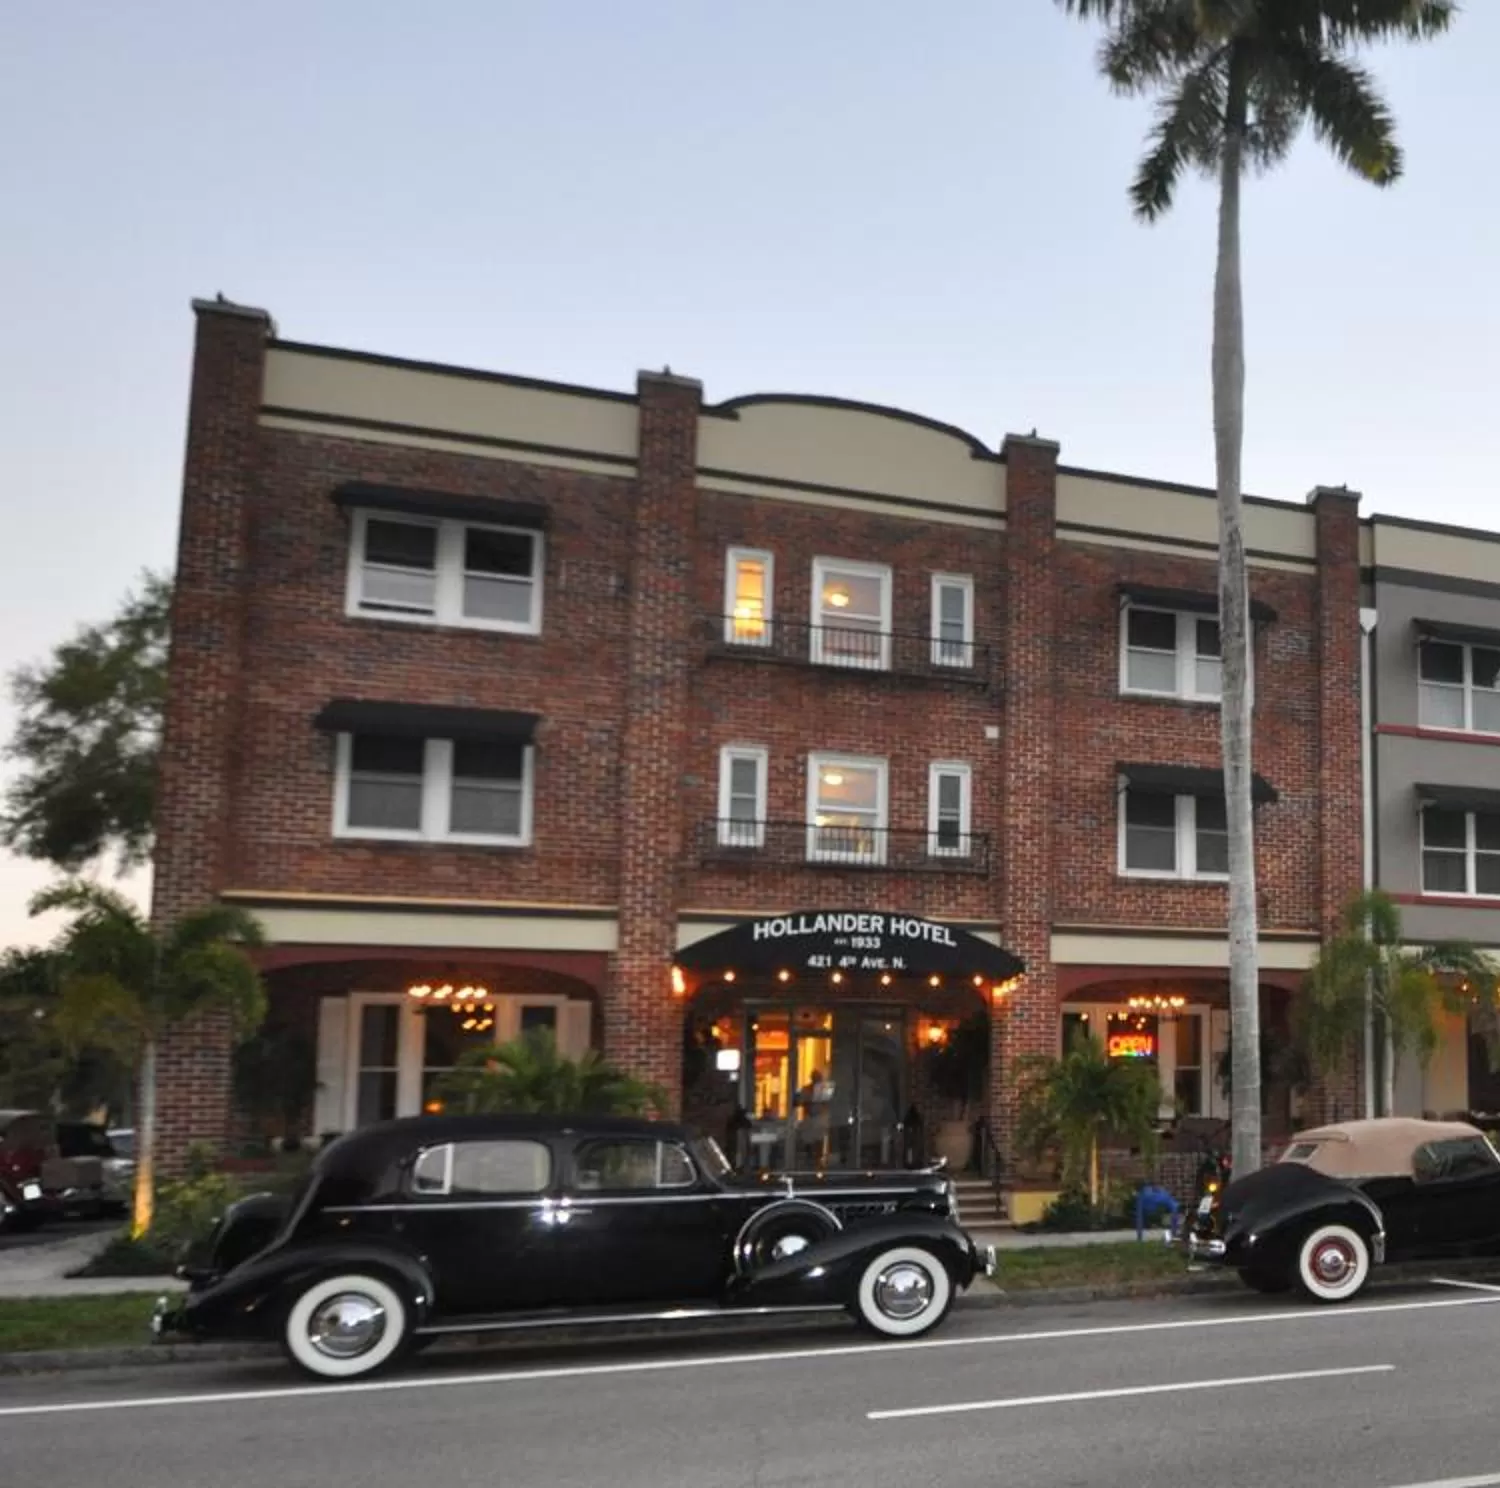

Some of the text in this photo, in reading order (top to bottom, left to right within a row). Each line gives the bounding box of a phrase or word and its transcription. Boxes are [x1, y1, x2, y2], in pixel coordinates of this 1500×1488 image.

[753, 914, 957, 947] HOLLANDER HOTEL
[851, 936, 881, 949] 1933
[807, 955, 831, 967] 421
[1110, 1035, 1152, 1055] OPEN
